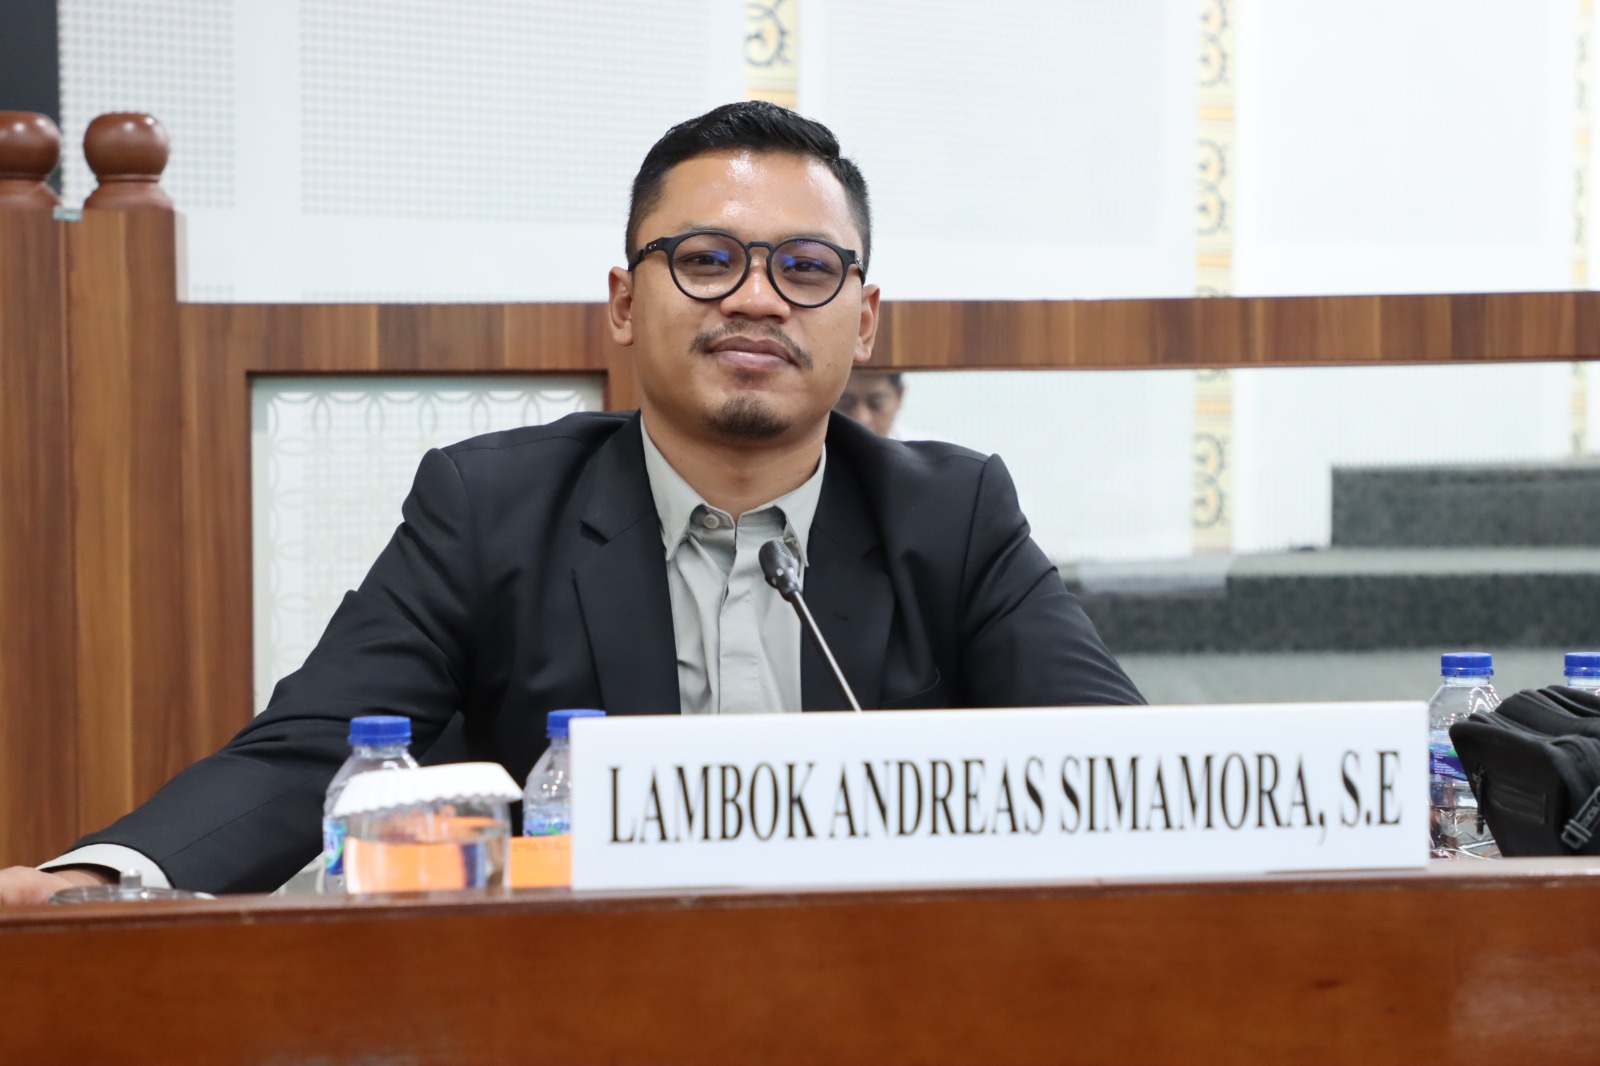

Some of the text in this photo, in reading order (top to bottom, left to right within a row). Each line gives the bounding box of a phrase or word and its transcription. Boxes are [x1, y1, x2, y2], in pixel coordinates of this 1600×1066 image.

[608, 750, 1401, 845] LAMBOK ANDREAS SIMAMORA, S.E
